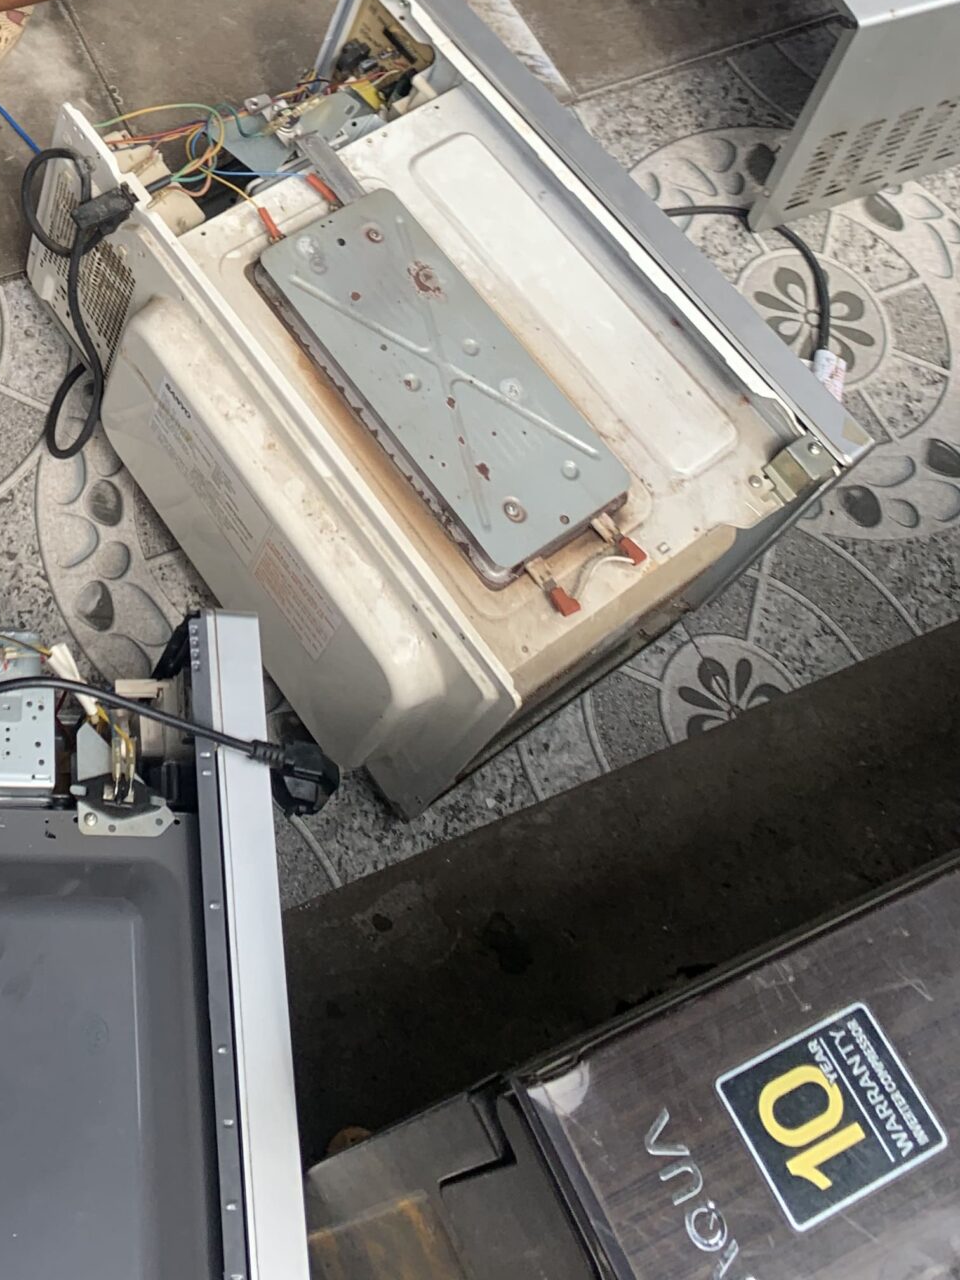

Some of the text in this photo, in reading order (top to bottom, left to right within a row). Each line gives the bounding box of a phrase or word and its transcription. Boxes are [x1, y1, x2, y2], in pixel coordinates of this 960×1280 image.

[165, 383, 191, 419] SANYO
[807, 1037, 838, 1086] YEAR
[846, 1018, 897, 1093] COMPRESSOR
[758, 1064, 866, 1191] 10
[829, 1029, 914, 1158] WARRANTY
